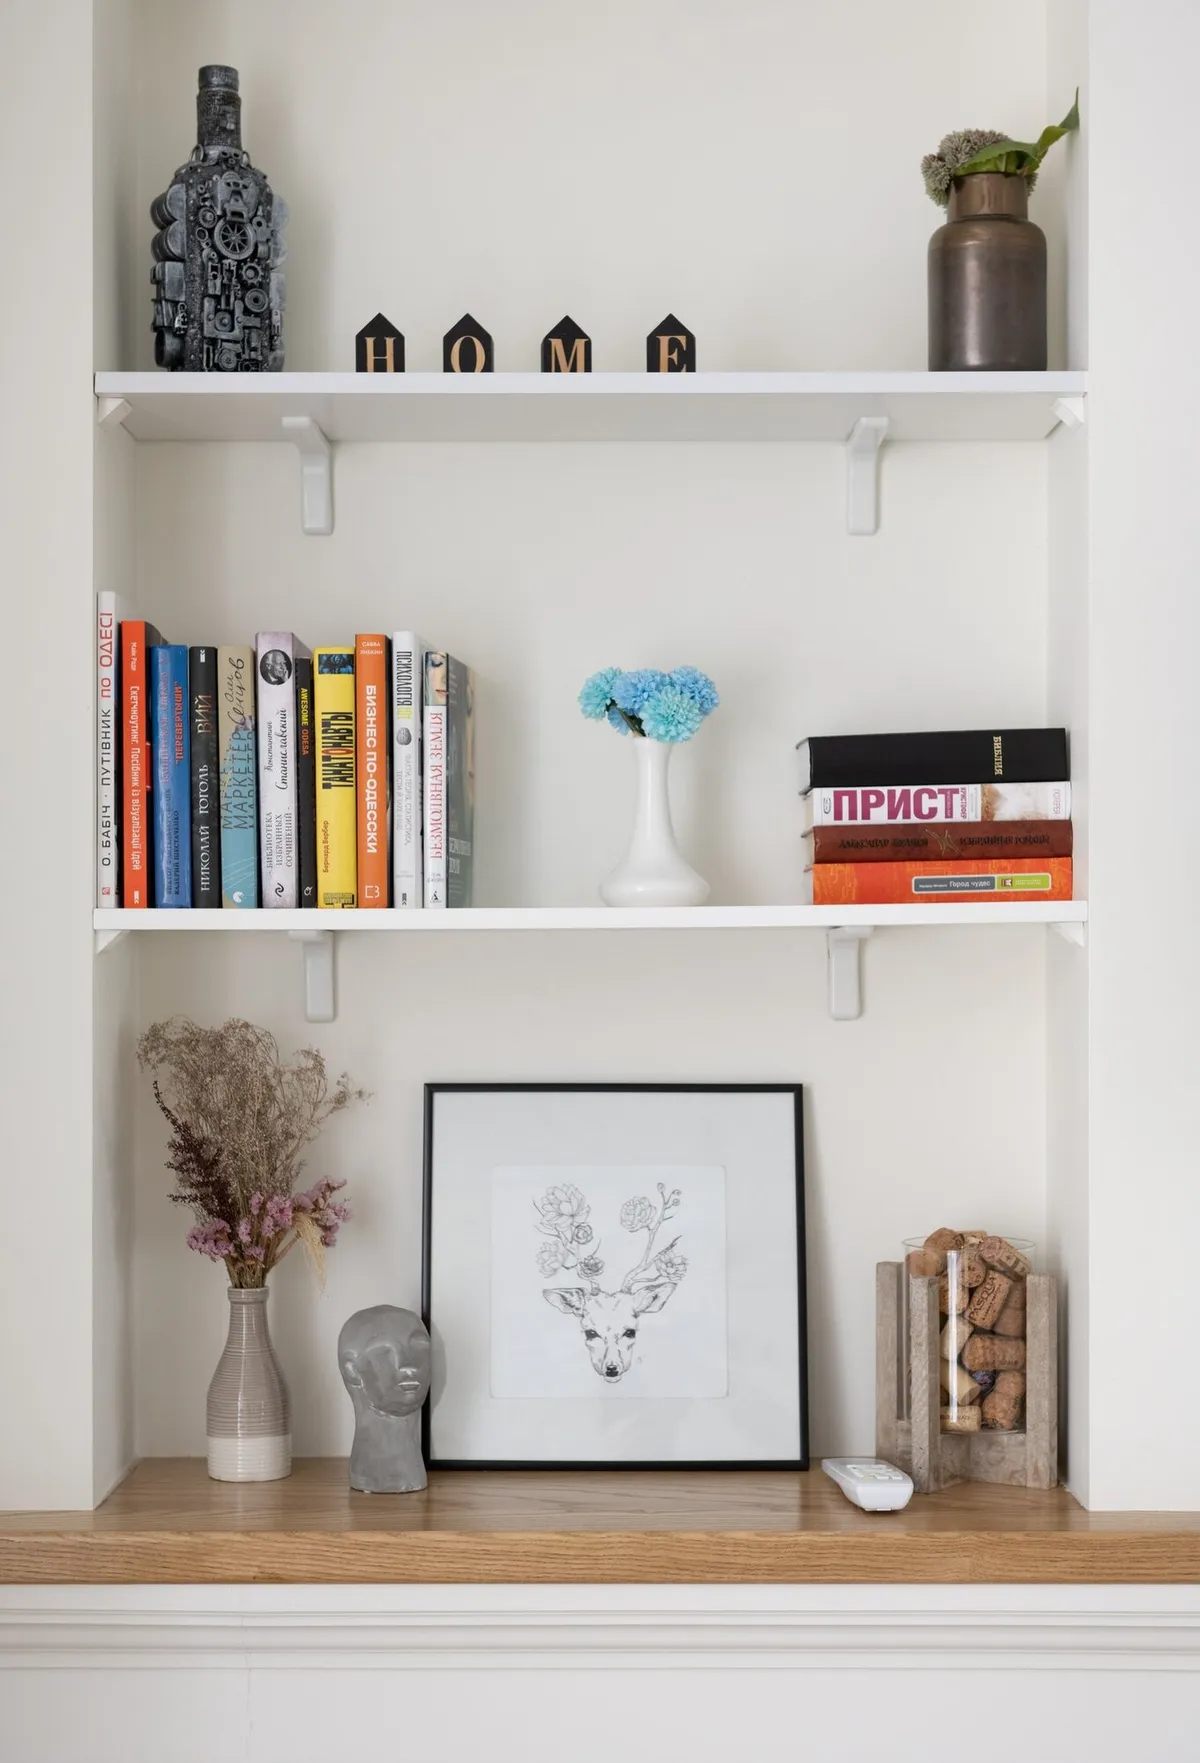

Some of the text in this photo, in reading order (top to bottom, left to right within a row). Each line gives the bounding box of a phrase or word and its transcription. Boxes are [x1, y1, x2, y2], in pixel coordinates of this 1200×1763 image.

[364, 335, 687, 372] H O M E
[100, 613, 113, 667] ОДЕСІ
[101, 678, 111, 698] ПО
[396, 650, 413, 706] ПСИХОЛОГІЯ
[129, 686, 140, 744] Скетчноутинг.
[195, 694, 212, 734] ВИЙ
[300, 688, 310, 756] AWESOME ODESA
[430, 712, 443, 760] ЗЕМЛЯ
[101, 709, 111, 785] ПУТІВНИК
[130, 748, 141, 787] Посібник
[274, 708, 288, 790] Станиславский
[321, 711, 354, 790] ТАНАТОНАВТЫ
[365, 685, 377, 853] БИЗНЕС ПО-ОДЕССКИ
[992, 736, 1003, 775] БИБЛИЯ
[232, 731, 248, 829] МАРКЕТЕР
[833, 788, 959, 821] ПРИСТ
[101, 805, 111, 848] БАБІЧ
[131, 799, 141, 849] візуалізації
[198, 764, 210, 892] НИКОЛАЙ ГОГОЛЬ
[322, 820, 330, 844] Вербер
[430, 764, 443, 859] БЕЗМОЛВНАЯ
[131, 851, 142, 870] ідей
[265, 811, 273, 868] БИБЛИОТЕКА
[275, 813, 283, 866] ИЗБРАННЫХ
[285, 812, 293, 867] СОЧИНЕНИЙ
[949, 880, 970, 888] Город
[970, 879, 991, 888] чудес
[968, 1275, 997, 1322] PASQUA
